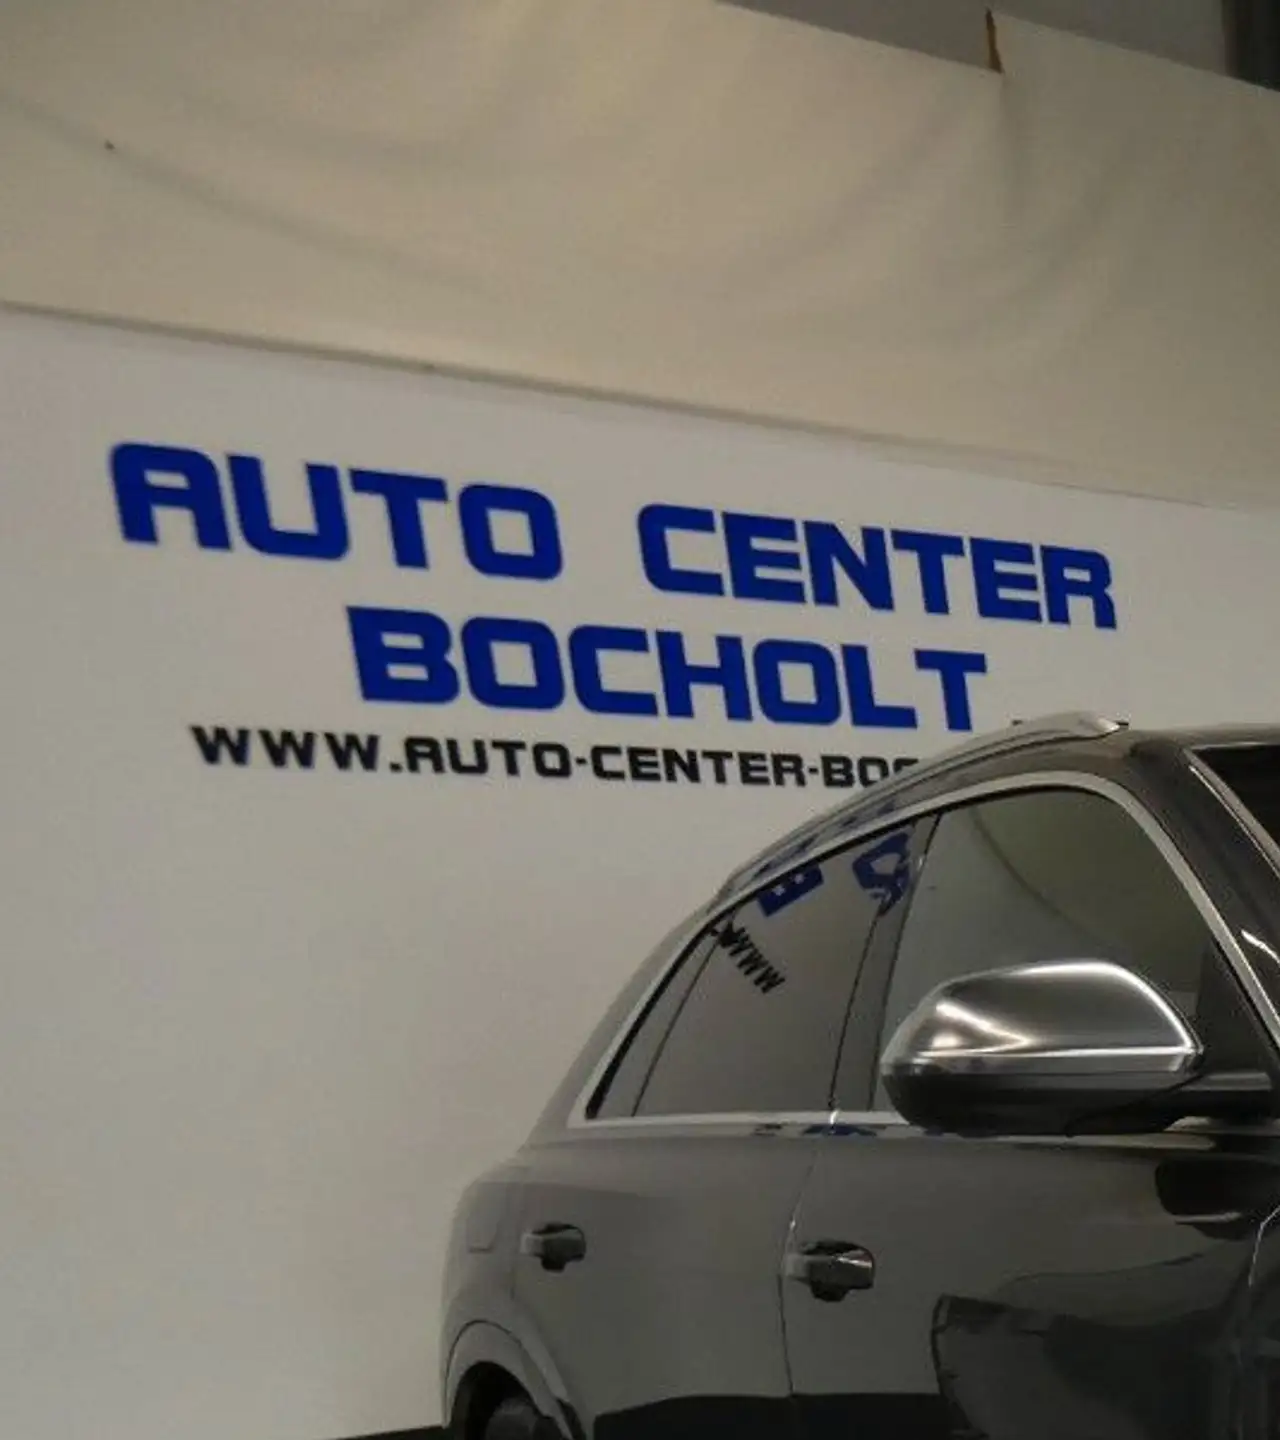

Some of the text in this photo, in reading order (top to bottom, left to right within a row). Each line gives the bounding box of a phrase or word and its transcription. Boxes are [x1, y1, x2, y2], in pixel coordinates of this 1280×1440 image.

[110, 441, 1117, 631] AUTO CENTER
[347, 605, 987, 733] BOCHOLT
